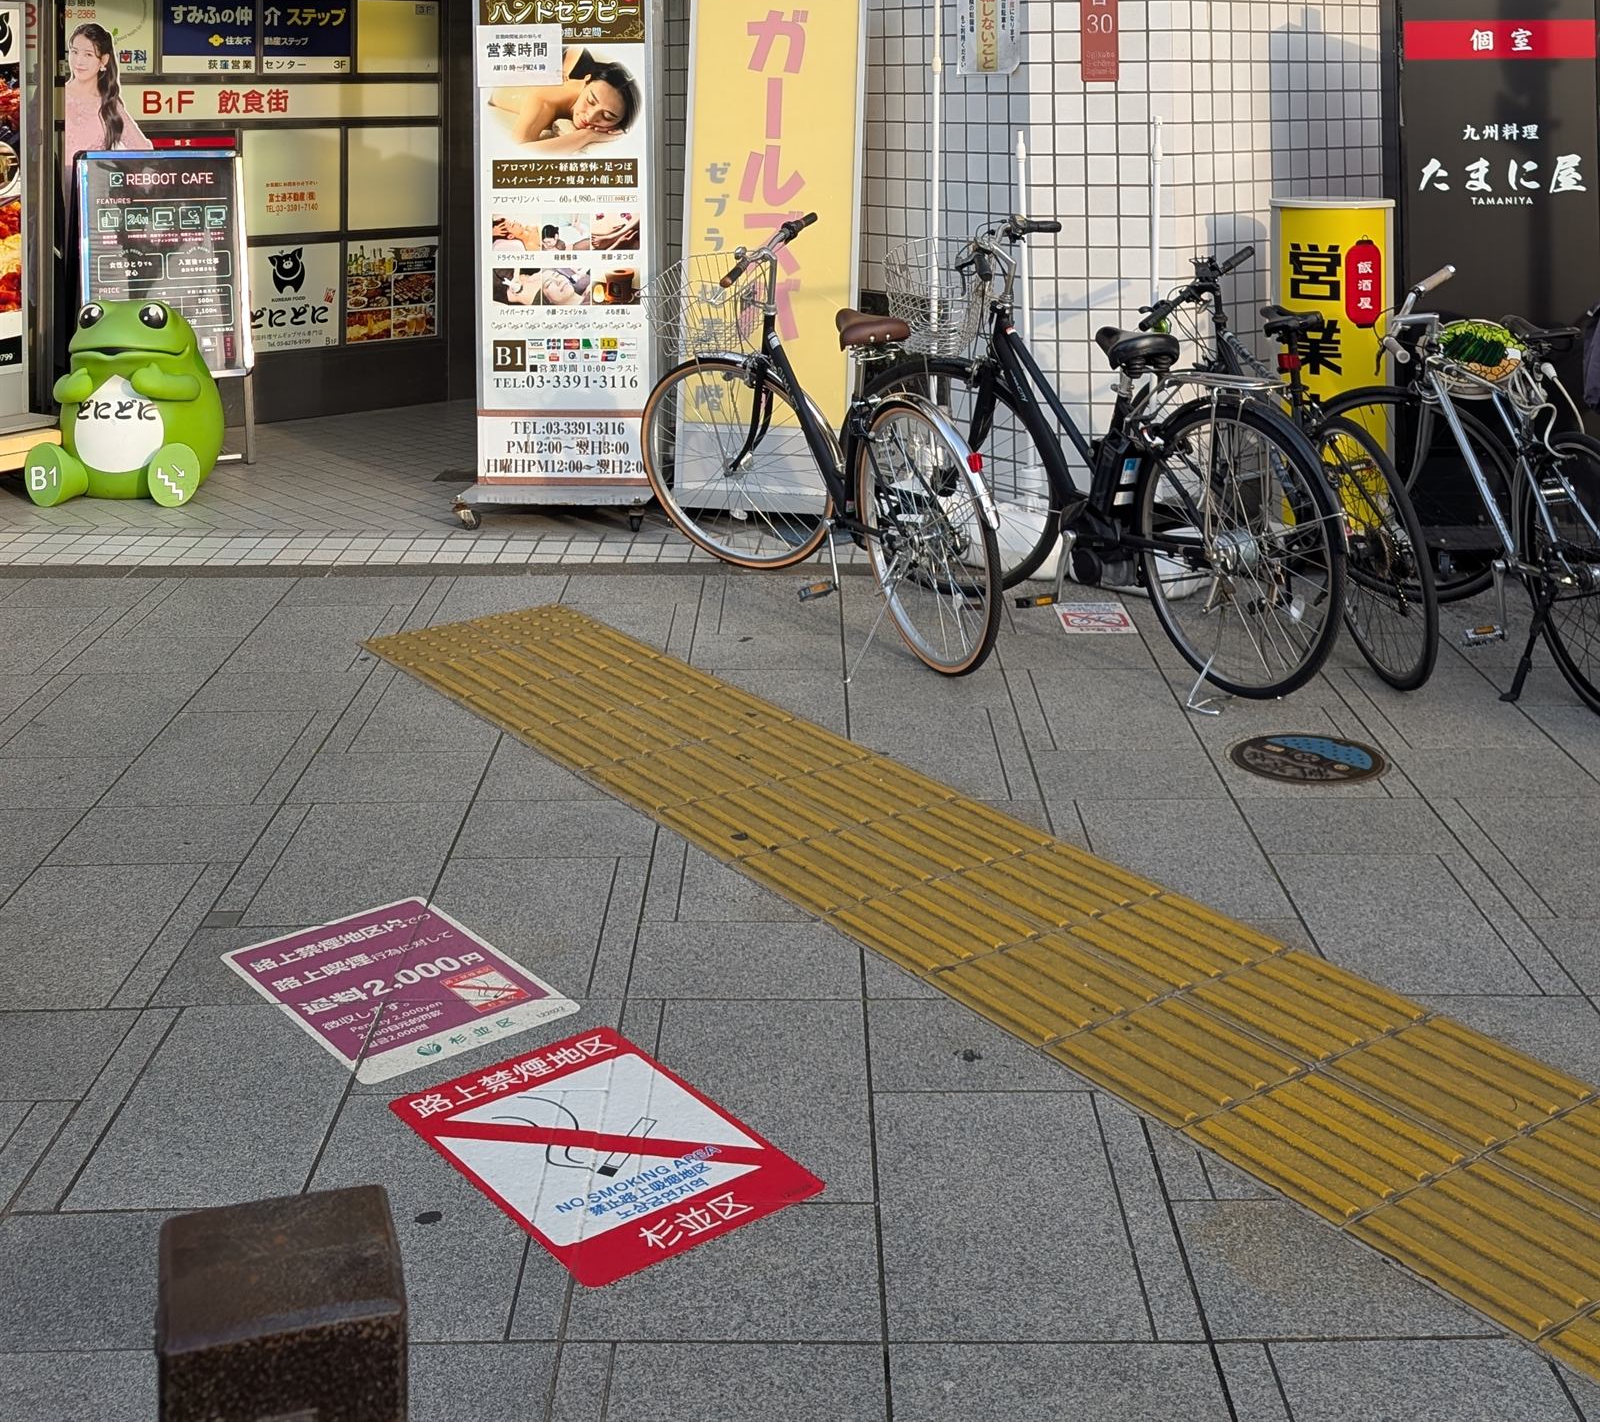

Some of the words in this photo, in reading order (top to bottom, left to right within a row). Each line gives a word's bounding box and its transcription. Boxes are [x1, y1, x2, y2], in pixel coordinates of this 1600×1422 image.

[1087, 14, 1113, 34] 30
[486, 42, 548, 58] 営業時間
[1469, 27, 1534, 52] 個室
[333, 60, 347, 70] 3F
[142, 89, 196, 115] B1F
[217, 88, 290, 114] 飲食街
[1462, 123, 1541, 141] 九州料理
[126, 172, 177, 186] REBOOT
[181, 172, 215, 185] CAFE
[1418, 153, 1588, 194] たまに屋
[96, 197, 132, 206] FEATURES
[1470, 196, 1534, 206] TAMANIYA
[1288, 242, 1343, 413] 営業
[495, 346, 524, 367] B1
[30, 465, 58, 491] B1
[409, 1033, 618, 1120] 路上禁煙地区
[554, 1196, 585, 1215] NO
[589, 1164, 671, 1205] SMOKING
[672, 1144, 722, 1172] AREA
[638, 1191, 755, 1250] 杉並区
